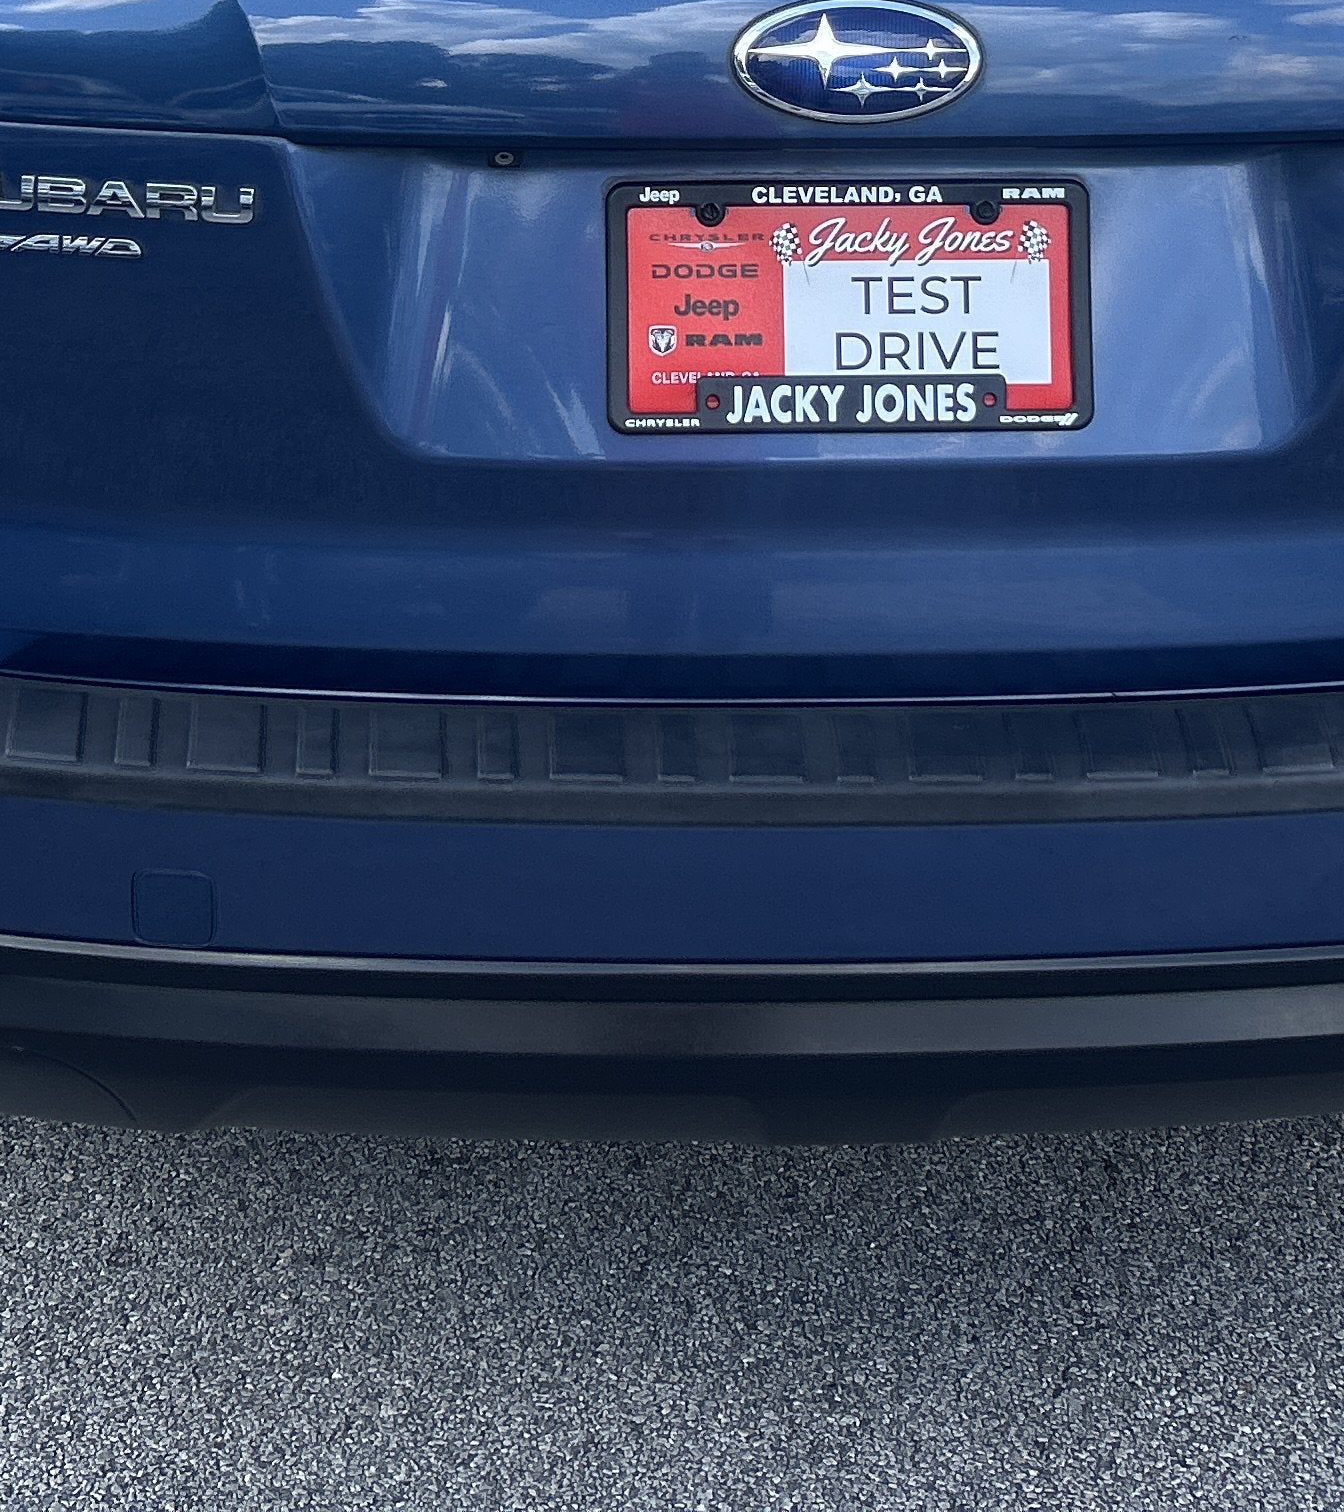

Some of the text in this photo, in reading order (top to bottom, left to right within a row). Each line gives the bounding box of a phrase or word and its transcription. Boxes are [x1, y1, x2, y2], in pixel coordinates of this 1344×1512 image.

[639, 186, 680, 204] Jeep
[751, 186, 943, 204] CLEVELAND, GA
[1002, 187, 1066, 199] RAM
[11, 234, 143, 257] AWD
[648, 233, 766, 242] CHRYSLER
[804, 216, 1014, 266] Jacky Jones
[651, 263, 760, 279] DODGE
[851, 275, 982, 315] TEST
[674, 293, 740, 321] Jeep
[685, 333, 763, 347] RAM
[835, 330, 1001, 370] DRIVE
[726, 383, 977, 424] JACKY JONES
[624, 418, 700, 428] CHRYSLER
[999, 414, 1064, 424] DODGE
